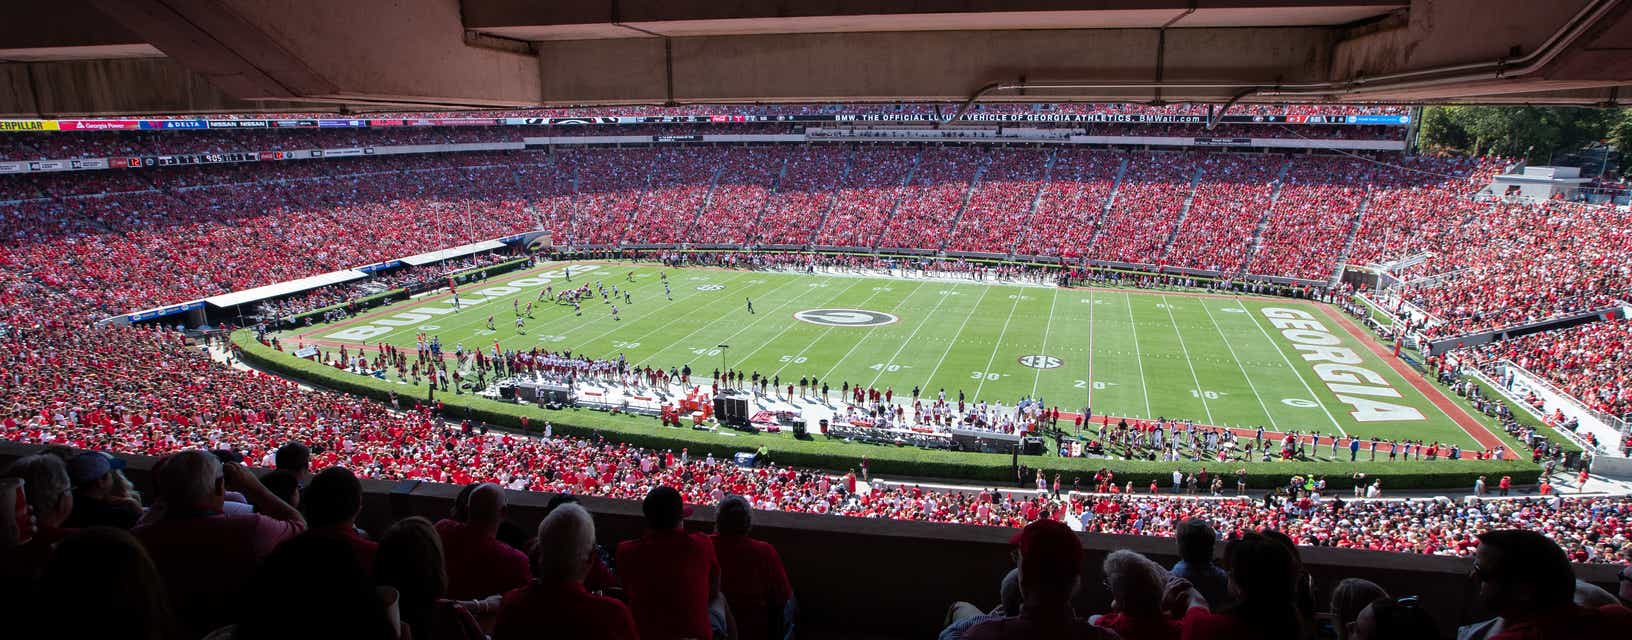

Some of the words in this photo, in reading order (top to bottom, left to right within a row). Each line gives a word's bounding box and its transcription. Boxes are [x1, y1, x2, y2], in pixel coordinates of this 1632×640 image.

[779, 355, 808, 364] 50
[869, 363, 901, 372] 40
[1260, 307, 1426, 422] GEORGIA
[970, 371, 1000, 380] 30
[1074, 380, 1105, 389] 20
[1190, 389, 1219, 399] 10
